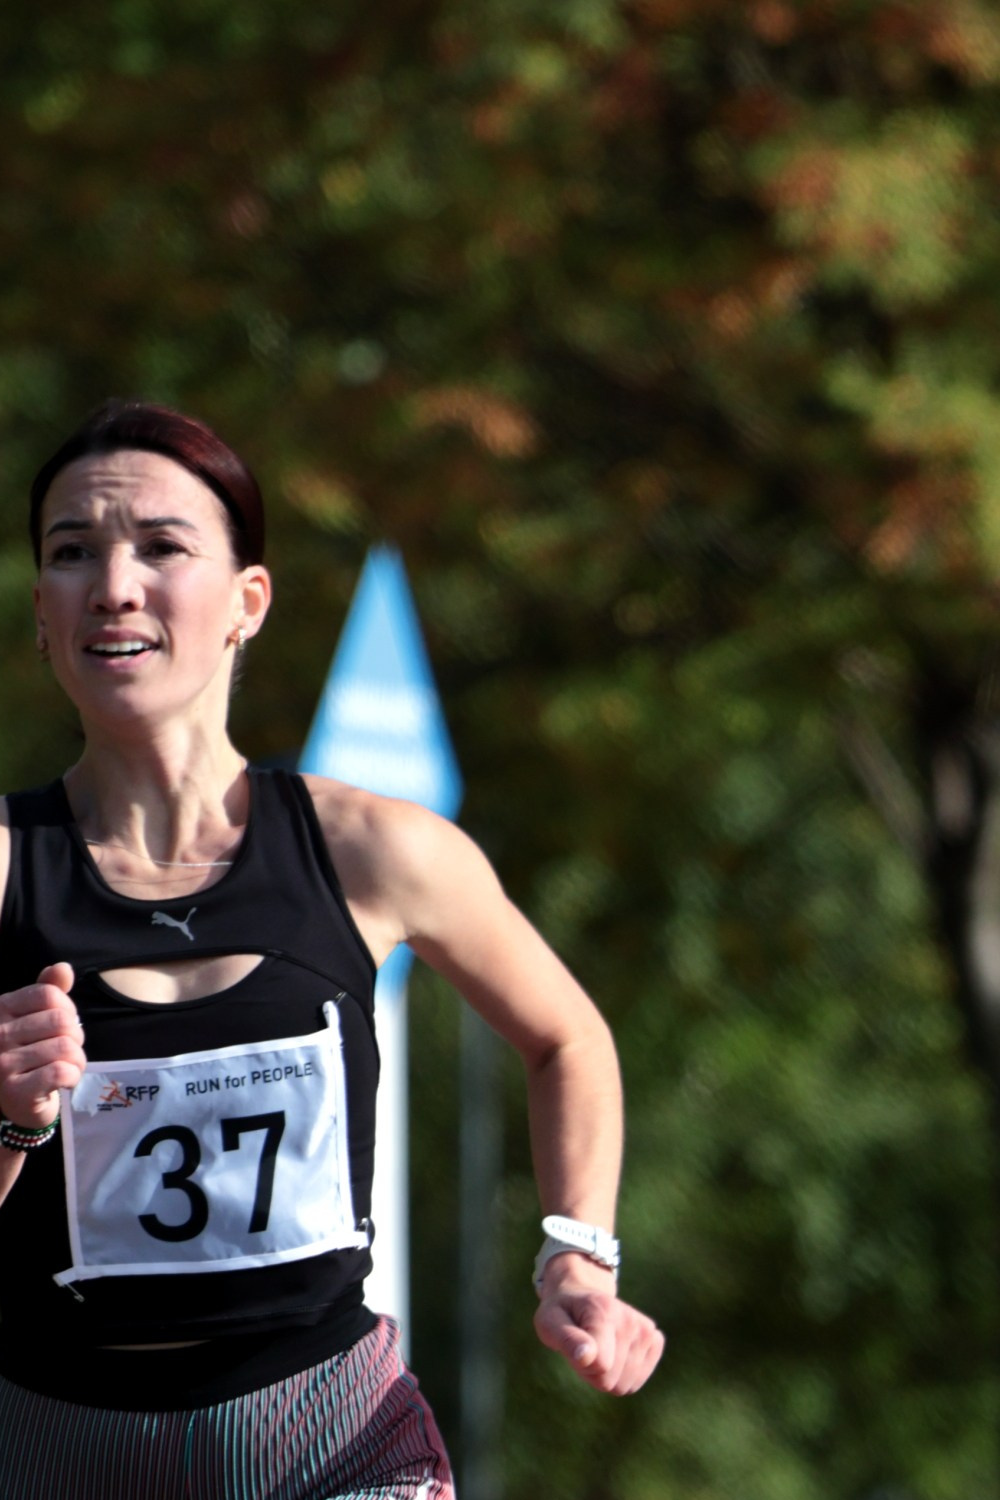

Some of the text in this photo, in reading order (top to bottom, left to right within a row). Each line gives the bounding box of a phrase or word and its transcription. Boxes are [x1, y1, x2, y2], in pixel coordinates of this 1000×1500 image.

[125, 1085, 160, 1101] RFP
[185, 1062, 313, 1096] RUN for PEOPLE
[133, 1110, 286, 1243] 37
